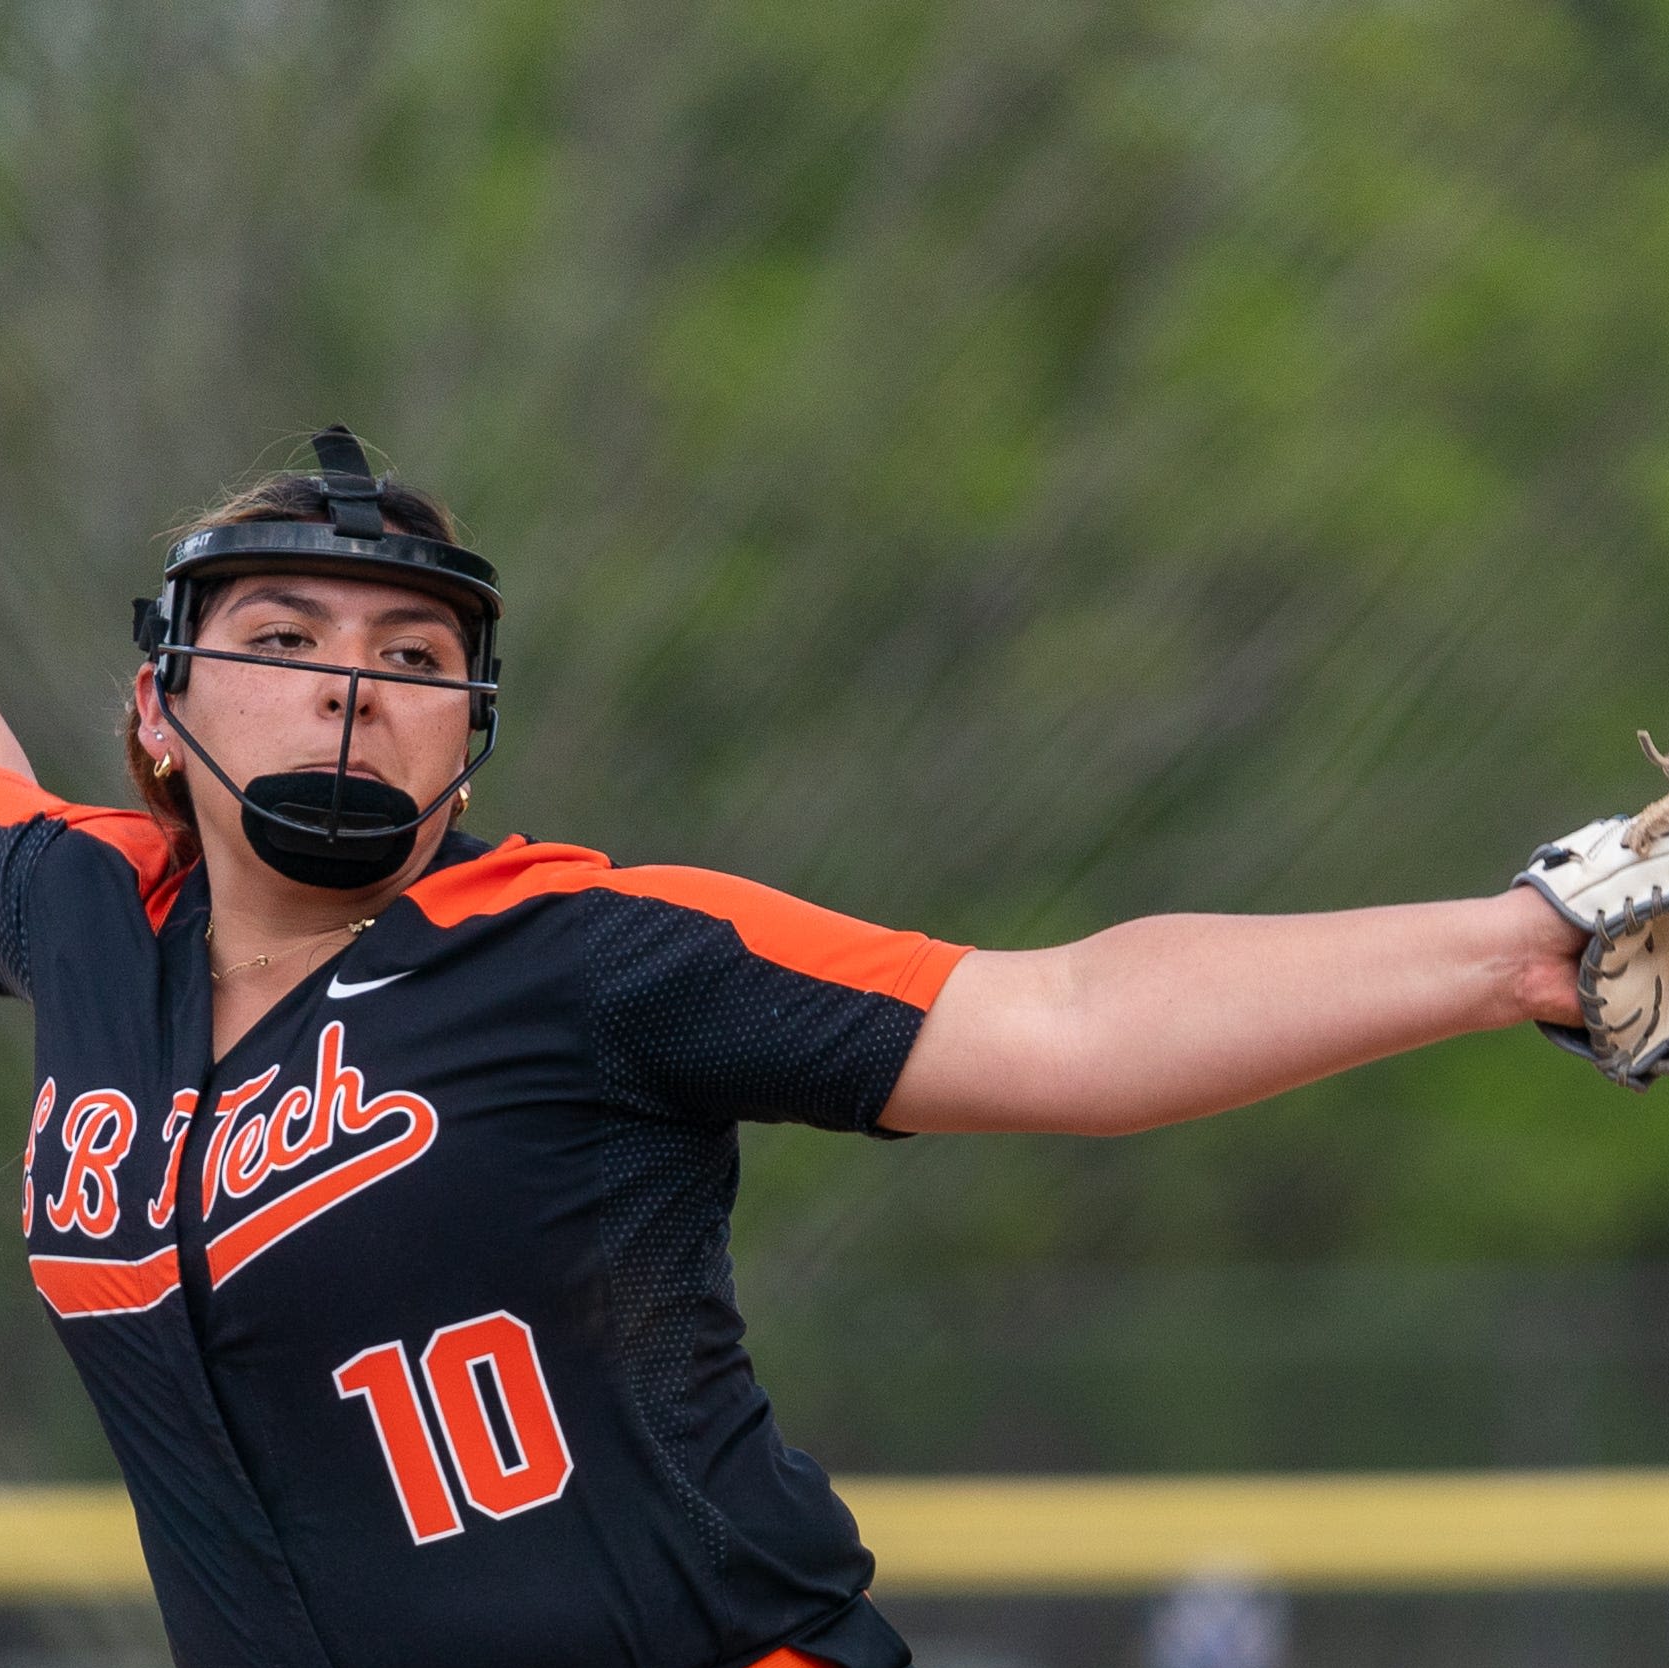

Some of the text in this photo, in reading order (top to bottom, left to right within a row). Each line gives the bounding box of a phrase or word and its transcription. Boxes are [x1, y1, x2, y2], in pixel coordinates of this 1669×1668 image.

[46, 1088, 137, 1239] B
[148, 1020, 372, 1229] Tech
[332, 1310, 574, 1546] 10
